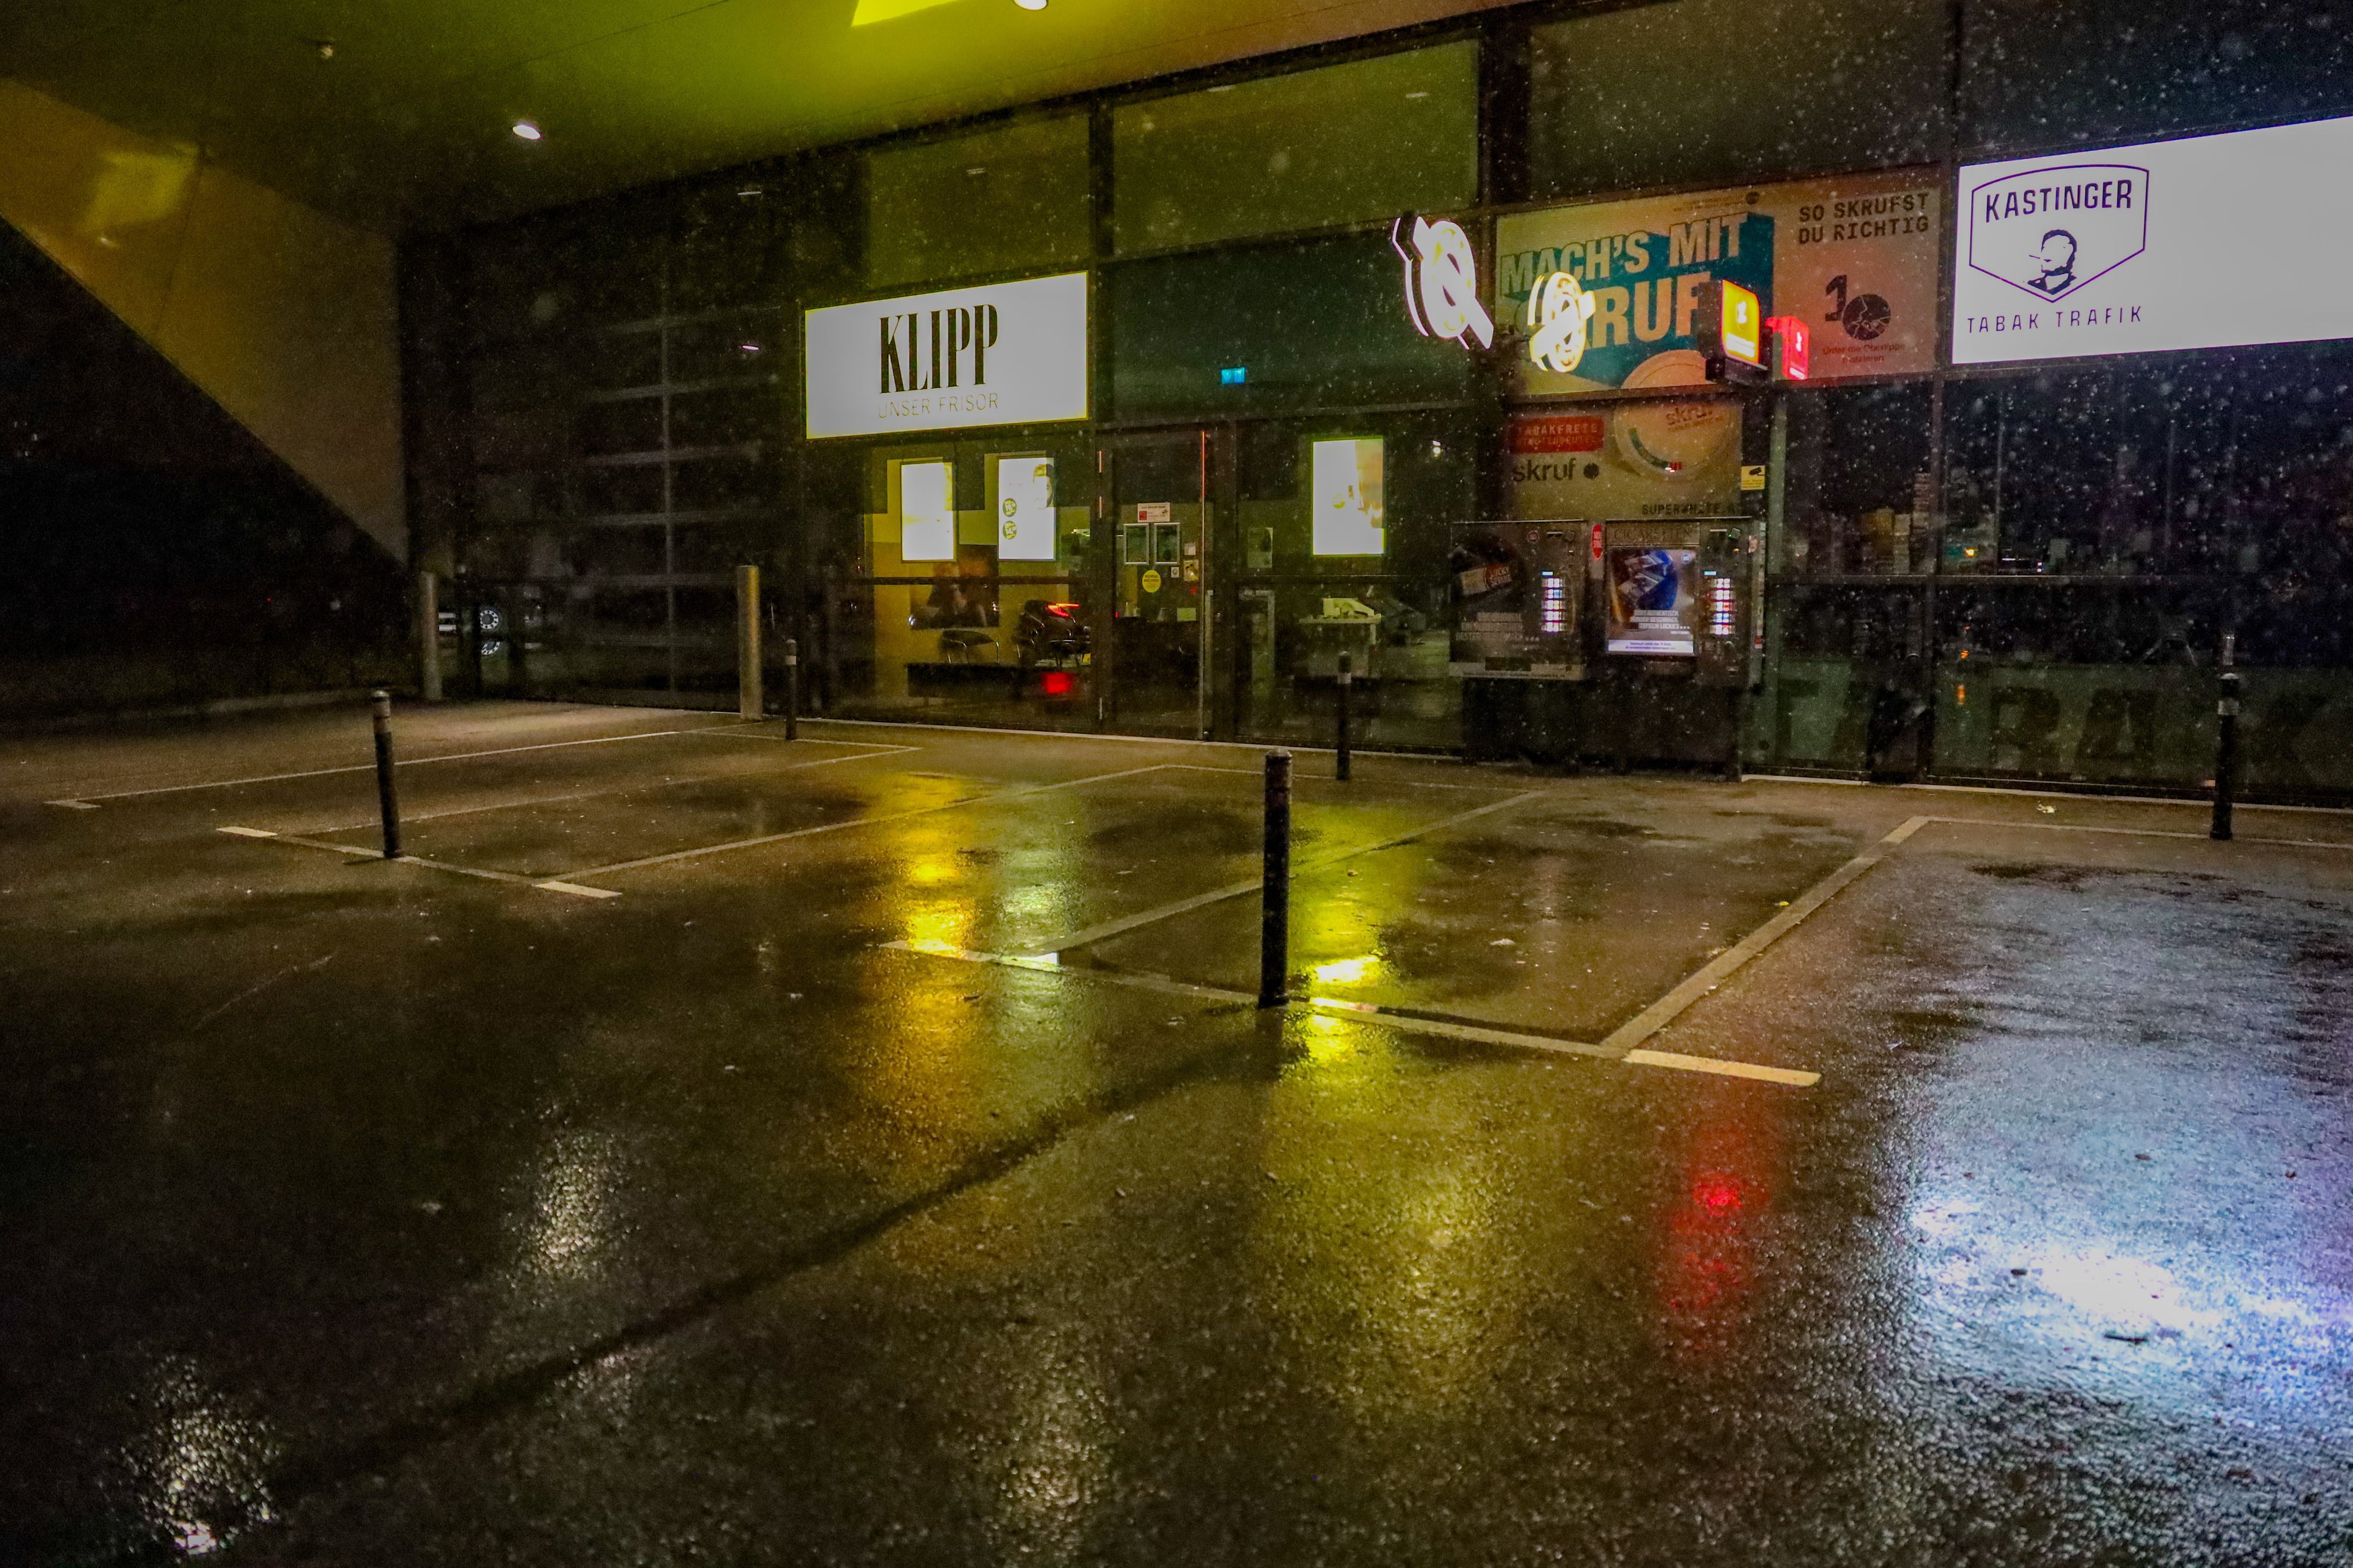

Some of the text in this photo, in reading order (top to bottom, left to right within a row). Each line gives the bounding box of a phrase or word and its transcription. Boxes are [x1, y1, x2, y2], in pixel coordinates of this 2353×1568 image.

[1798, 192, 1929, 223] SO SKRUFST
[1985, 179, 2132, 223] KASTINGER
[1798, 215, 1929, 245] DU RICHTIG
[1499, 212, 1749, 296] MACH'S MIT
[1967, 305, 2142, 333] TABAK TRAFIK
[879, 303, 998, 394] KLIPP
[878, 398, 931, 419] UNSER
[1512, 457, 1577, 482] skruf
